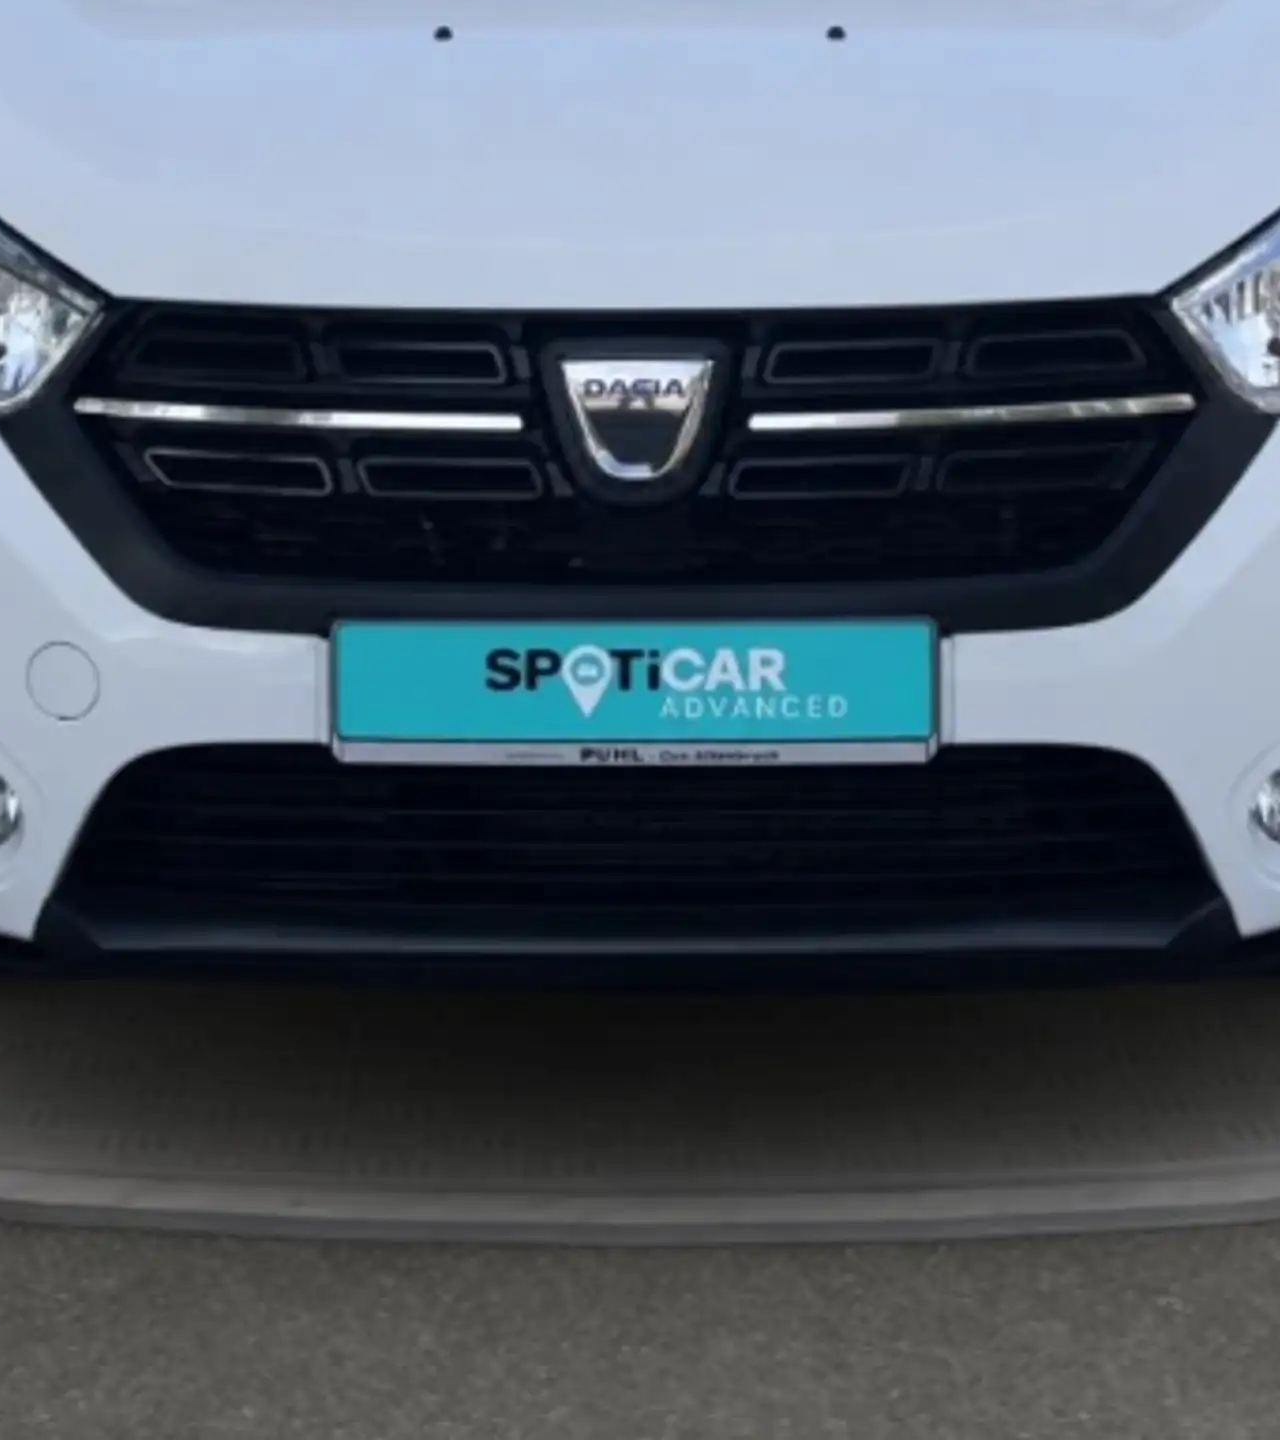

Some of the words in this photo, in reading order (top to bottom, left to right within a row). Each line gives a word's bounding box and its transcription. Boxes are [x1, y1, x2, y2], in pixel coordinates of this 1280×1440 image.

[583, 378, 685, 398] DACIA
[659, 694, 849, 719] ADVANCED
[579, 747, 644, 762] PUHL
